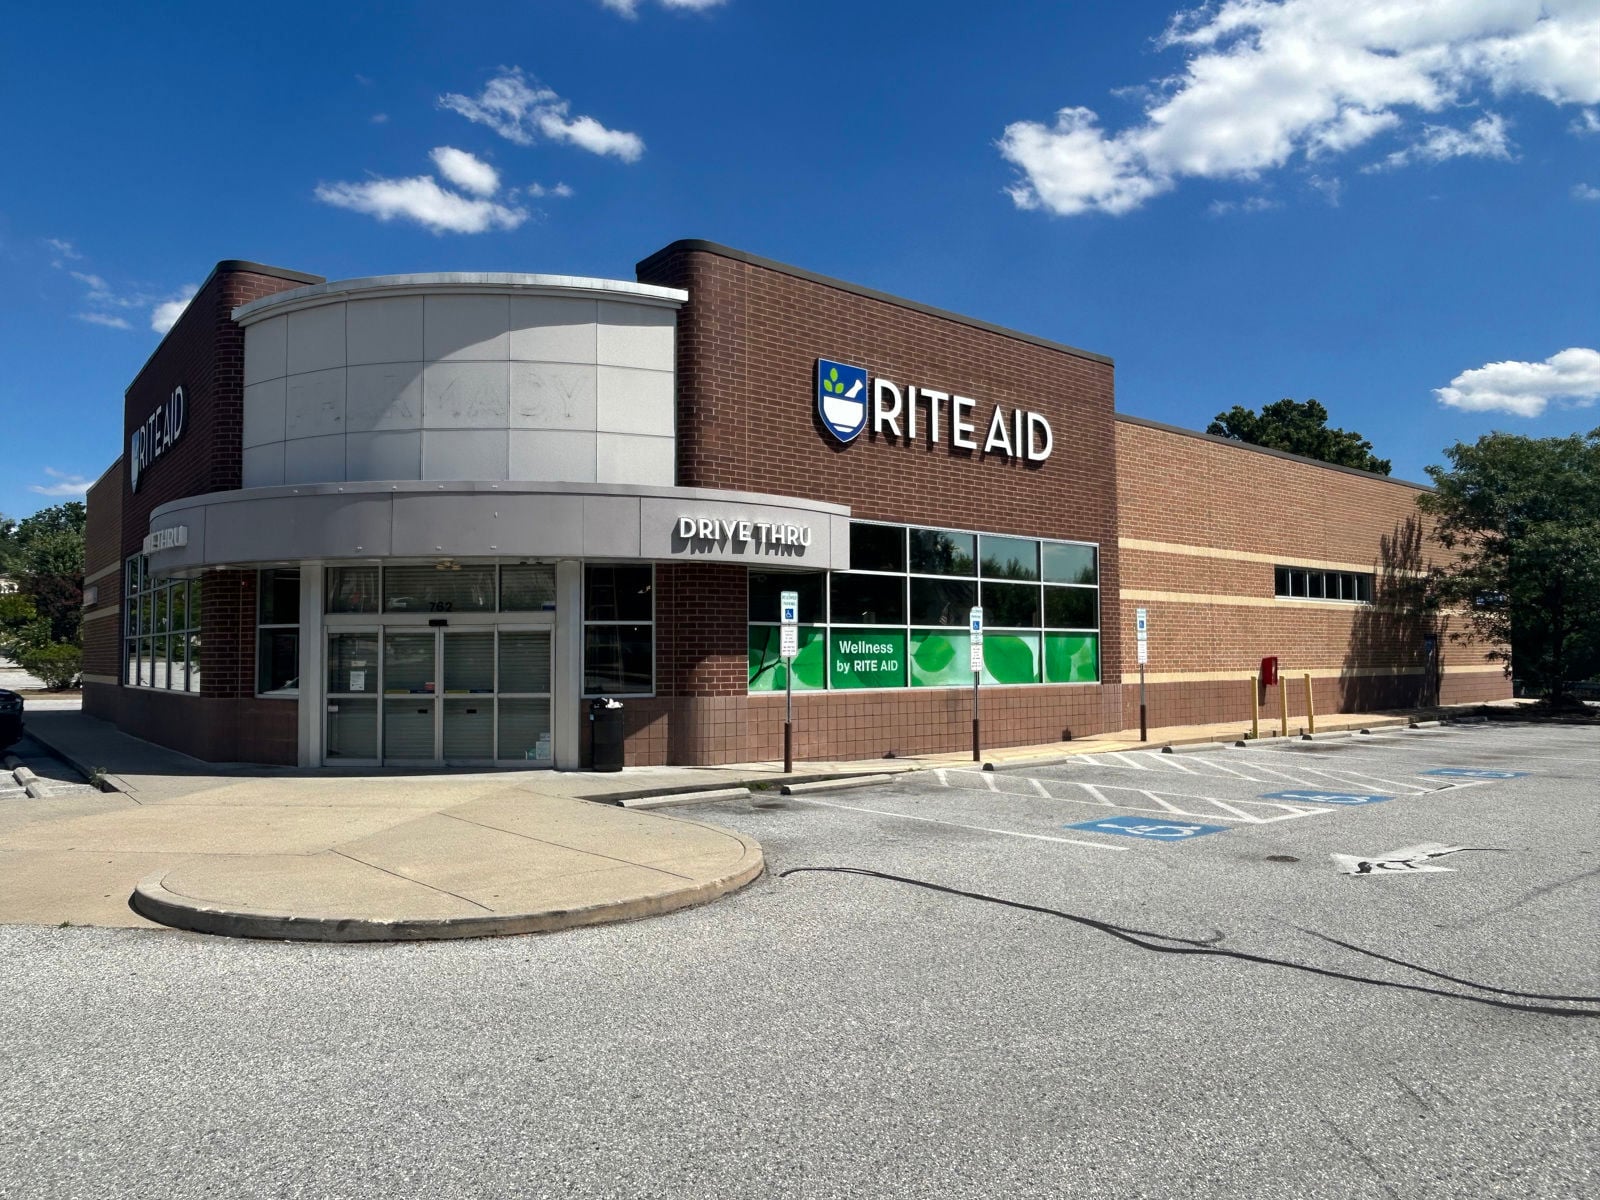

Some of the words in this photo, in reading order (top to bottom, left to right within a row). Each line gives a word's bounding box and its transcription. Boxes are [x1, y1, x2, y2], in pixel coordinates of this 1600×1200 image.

[139, 404, 162, 472] RITE
[162, 385, 183, 453] AID
[874, 377, 977, 449] RITE
[984, 404, 1053, 461] AID
[680, 517, 751, 541] DRIVE
[756, 522, 811, 547] THRU
[428, 600, 453, 612] 762
[839, 640, 894, 654] Wellness
[836, 659, 851, 675] by
[854, 659, 878, 672] RITE
[880, 659, 899, 672] AID
